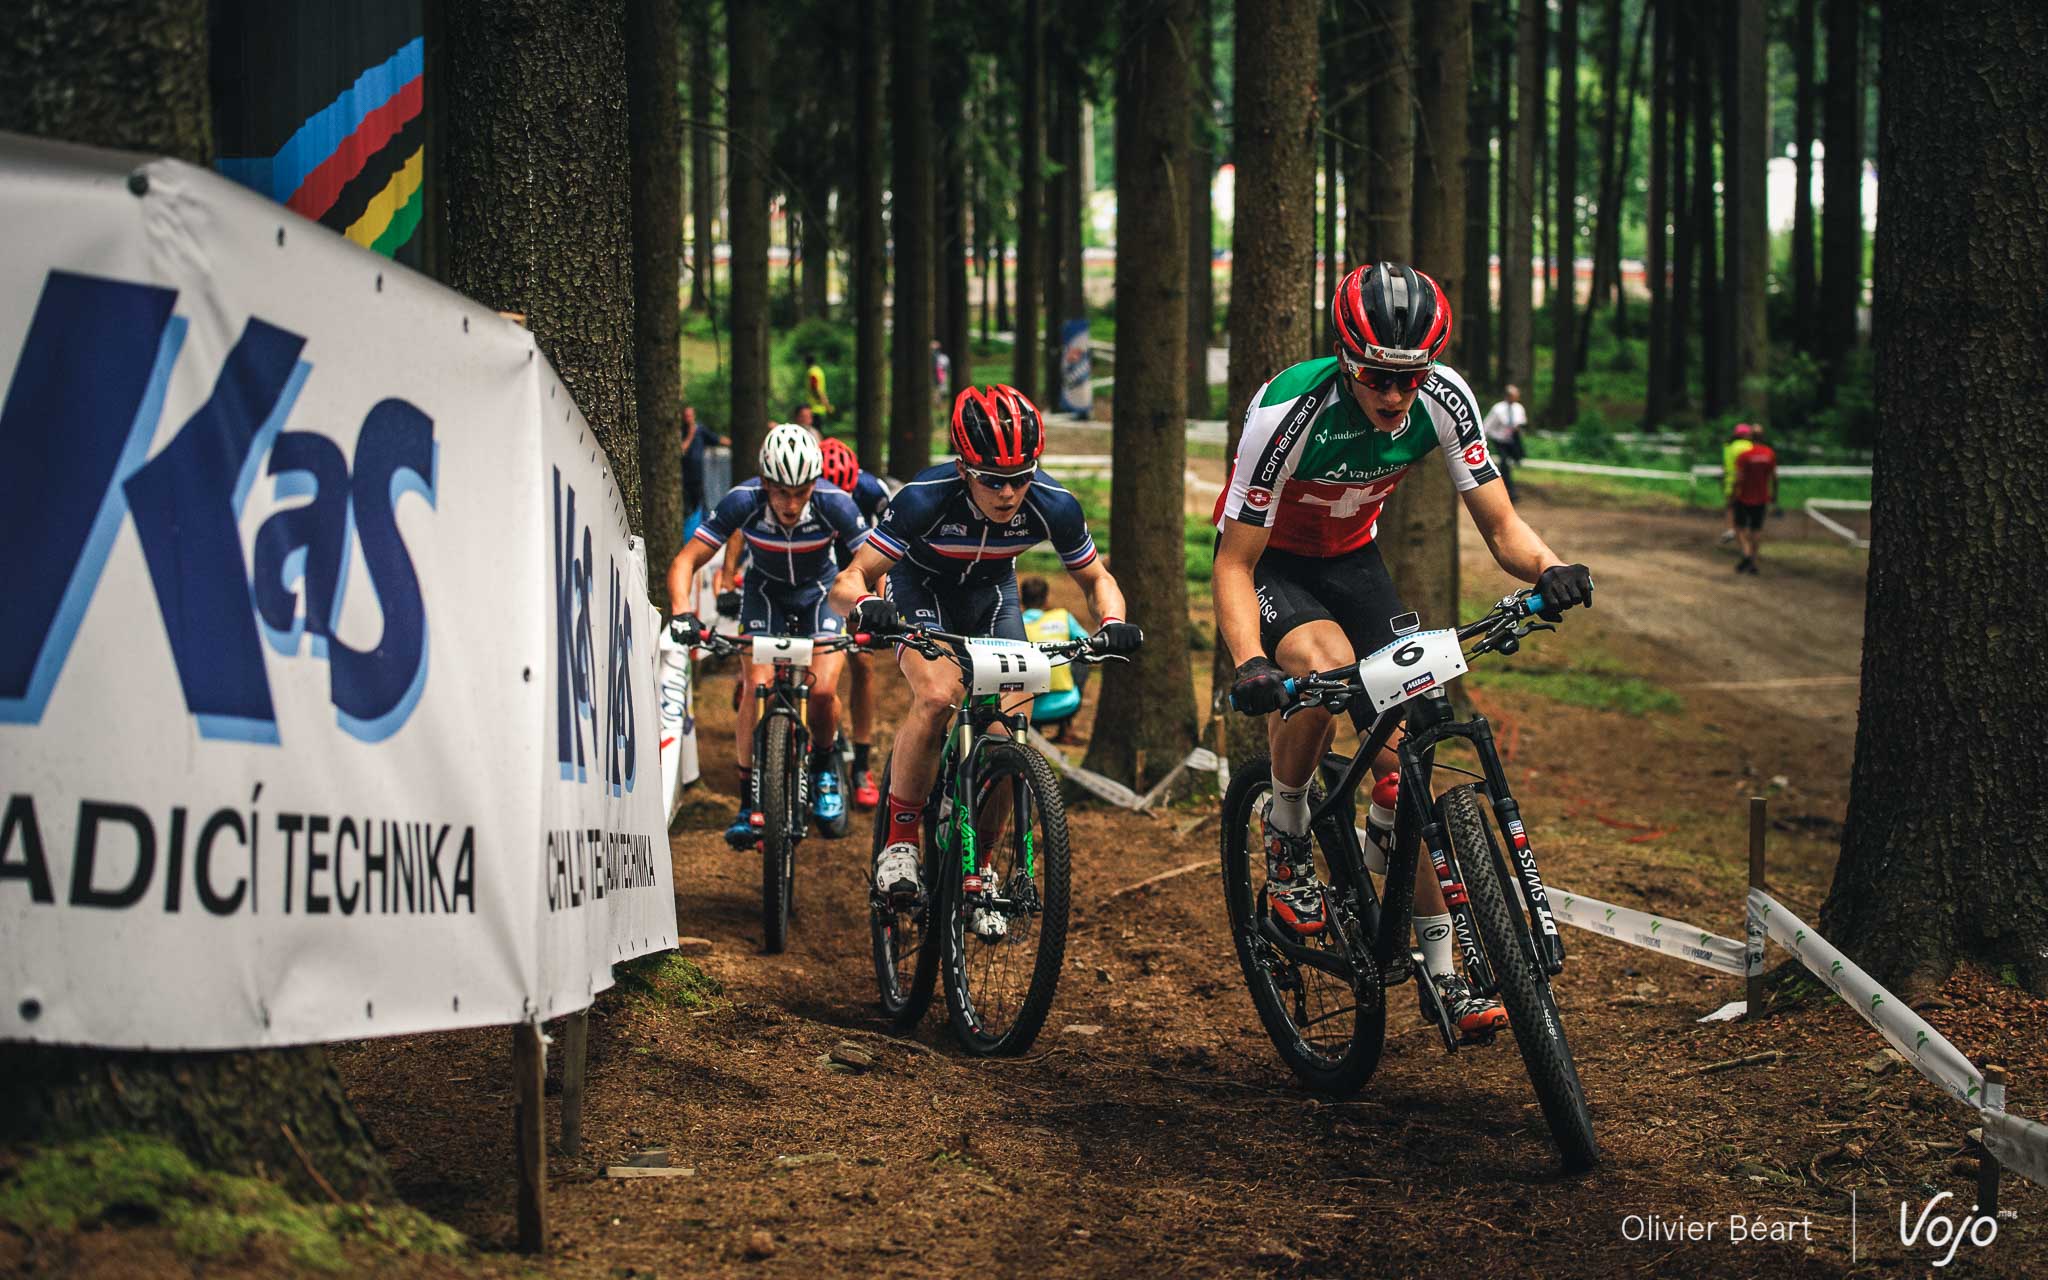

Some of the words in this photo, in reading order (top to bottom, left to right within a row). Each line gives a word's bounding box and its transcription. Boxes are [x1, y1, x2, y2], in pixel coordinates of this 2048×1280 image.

[1424, 372, 1474, 437] ŠKODA
[1349, 463, 1408, 480] vaudoise
[606, 553, 637, 798] Kas
[992, 653, 1028, 673] 11
[1393, 641, 1425, 667] 6
[277, 813, 476, 914] TECHNIKA
[1518, 849, 1547, 902] SWISS
[1452, 913, 1480, 966] SWISS
[1536, 907, 1558, 936] DT
